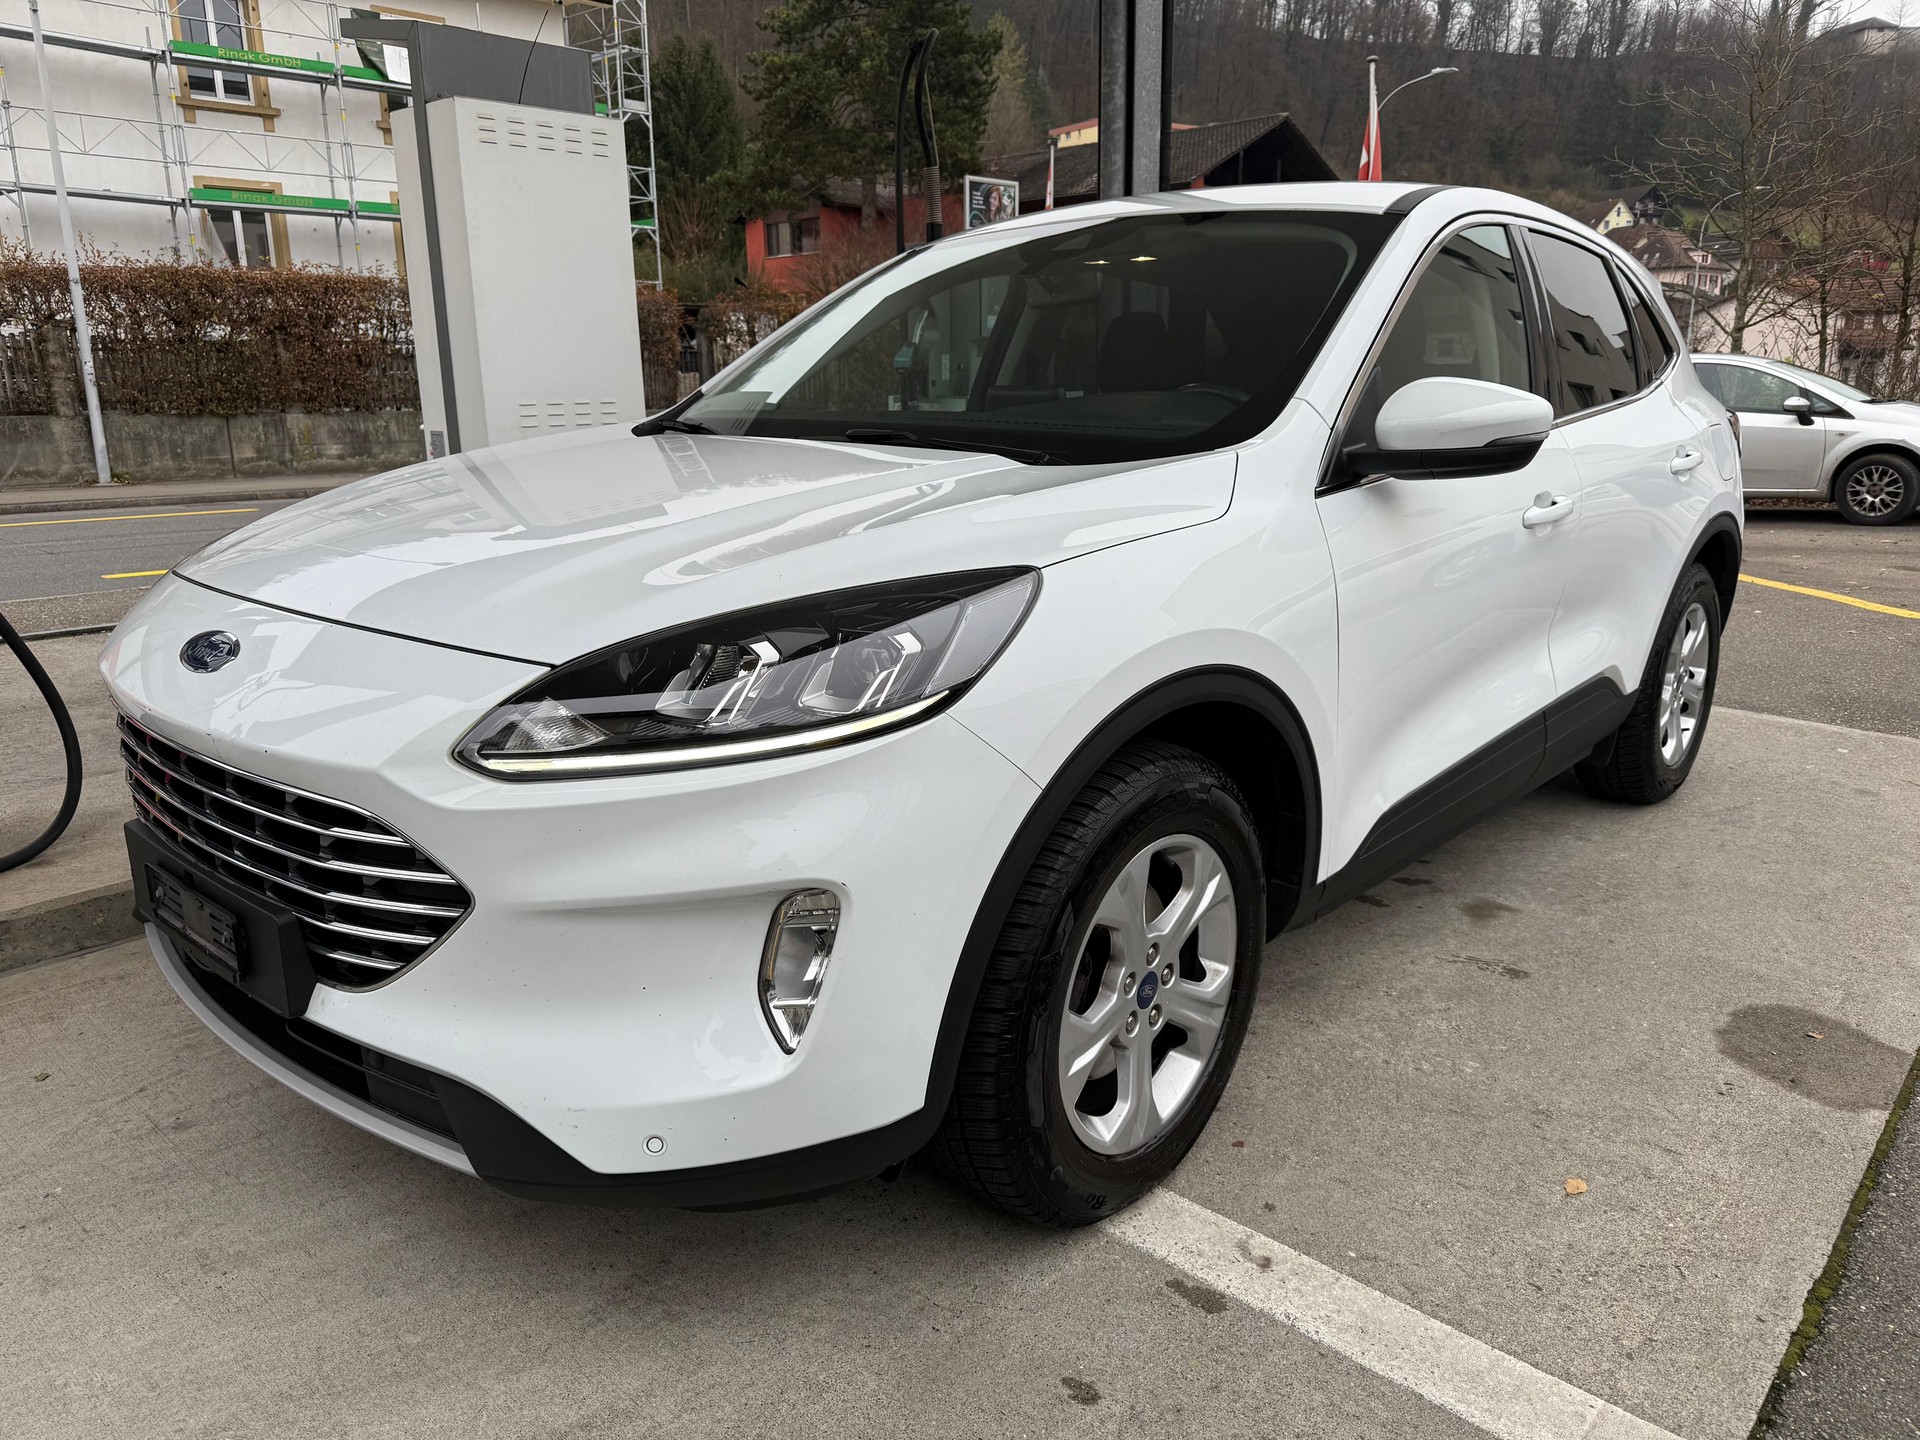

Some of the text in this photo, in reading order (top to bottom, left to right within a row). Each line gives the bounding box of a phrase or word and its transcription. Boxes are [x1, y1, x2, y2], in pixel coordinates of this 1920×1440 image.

[217, 47, 301, 67] Rinak GmbH
[231, 190, 314, 207] Rinak GmbH
